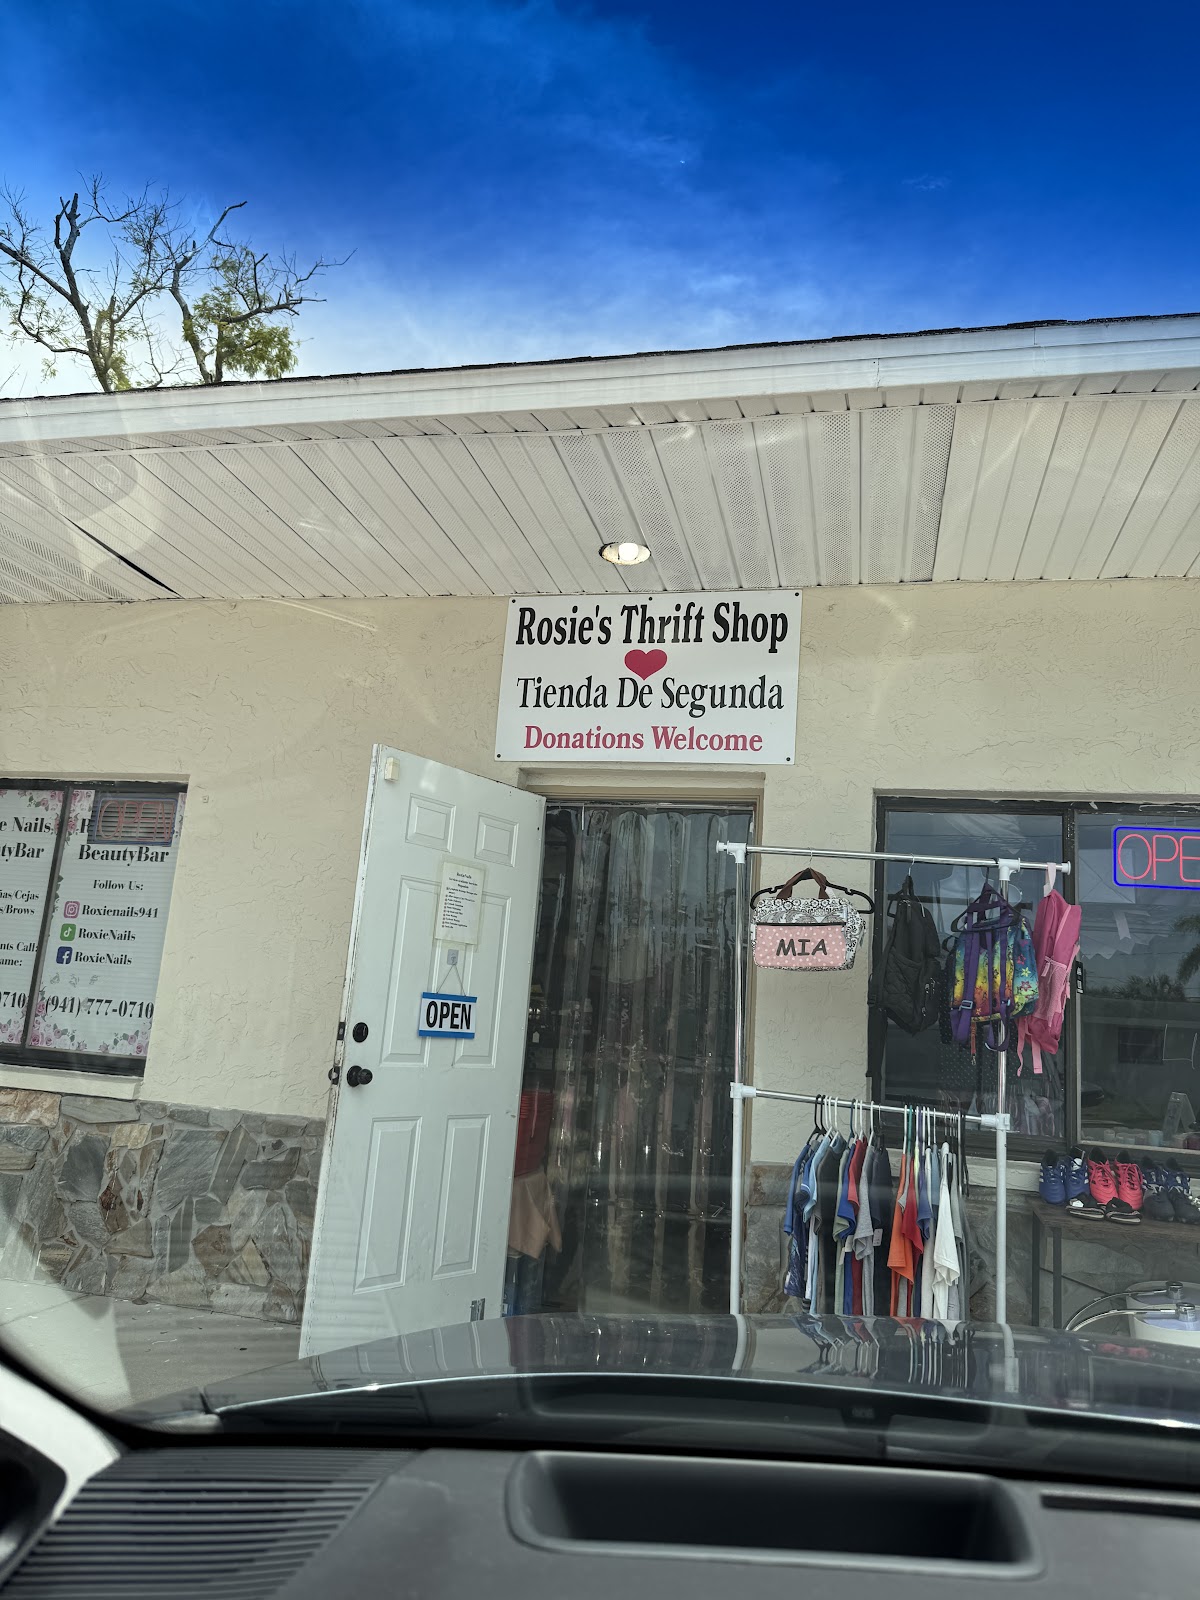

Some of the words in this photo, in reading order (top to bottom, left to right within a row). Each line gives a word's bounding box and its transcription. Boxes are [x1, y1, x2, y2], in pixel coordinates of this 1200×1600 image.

[515, 604, 612, 646] Rosie's
[621, 601, 705, 644] Thrift
[712, 601, 789, 653] Shop
[516, 675, 609, 709] Tienda
[616, 677, 653, 709] De
[661, 675, 784, 718] Segunda
[523, 725, 644, 750] Donations
[651, 725, 763, 752] Welcome
[97, 800, 175, 841] OPEN
[78, 844, 170, 867] BeautyBar
[93, 879, 125, 890] Follow
[128, 881, 144, 891] Us:
[81, 904, 159, 918] Roxienails941
[78, 927, 136, 941] RoxieNails
[74, 951, 133, 965] RoxieNails
[776, 939, 828, 956] MIA
[45, 995, 81, 1018] (941)
[87, 998, 154, 1019] 777-0710
[426, 1000, 471, 1030] OPEN
